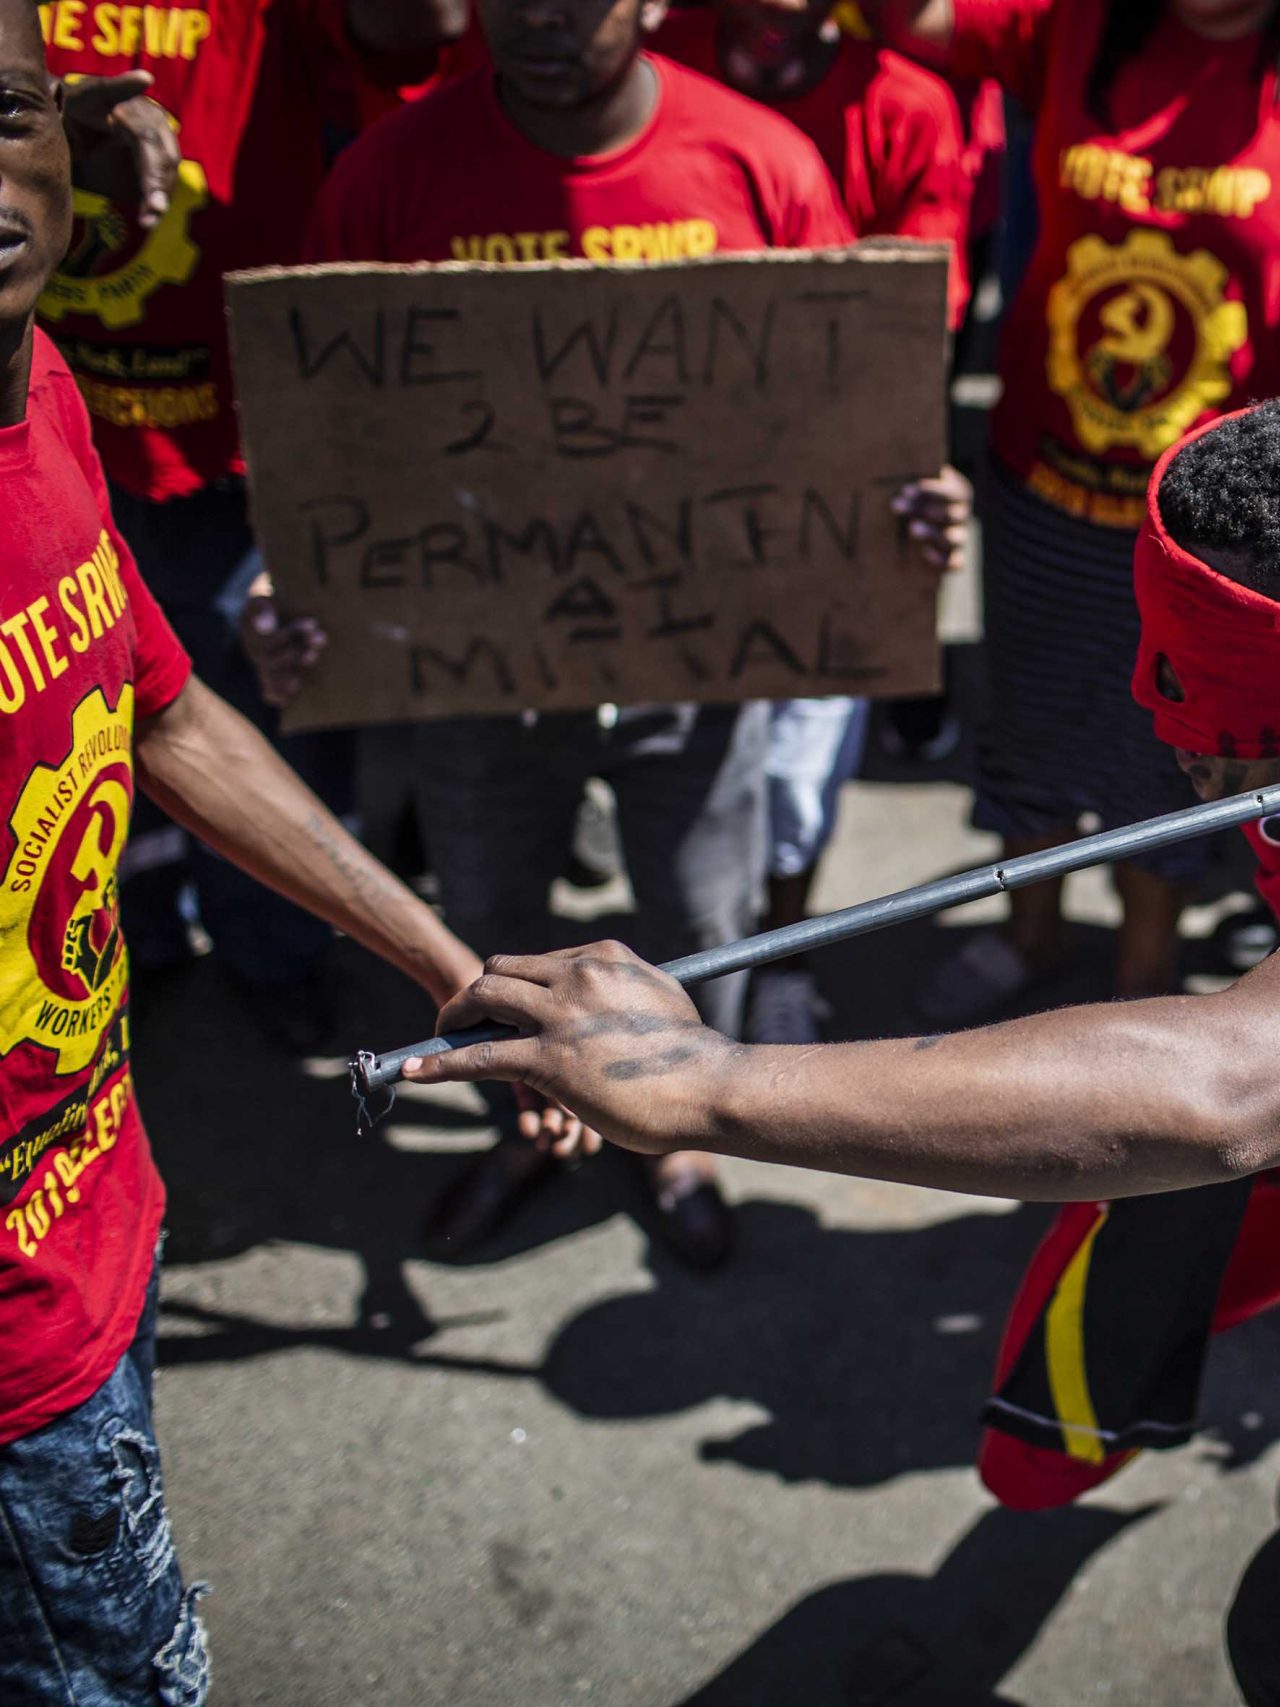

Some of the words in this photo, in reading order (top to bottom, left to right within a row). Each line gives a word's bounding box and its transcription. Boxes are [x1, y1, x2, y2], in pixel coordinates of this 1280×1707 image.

[286, 303, 482, 389] WE
[530, 288, 872, 397] WANT
[442, 399, 512, 456] 2
[549, 392, 688, 457] BE
[10, 767, 79, 893] SOCIALIST
